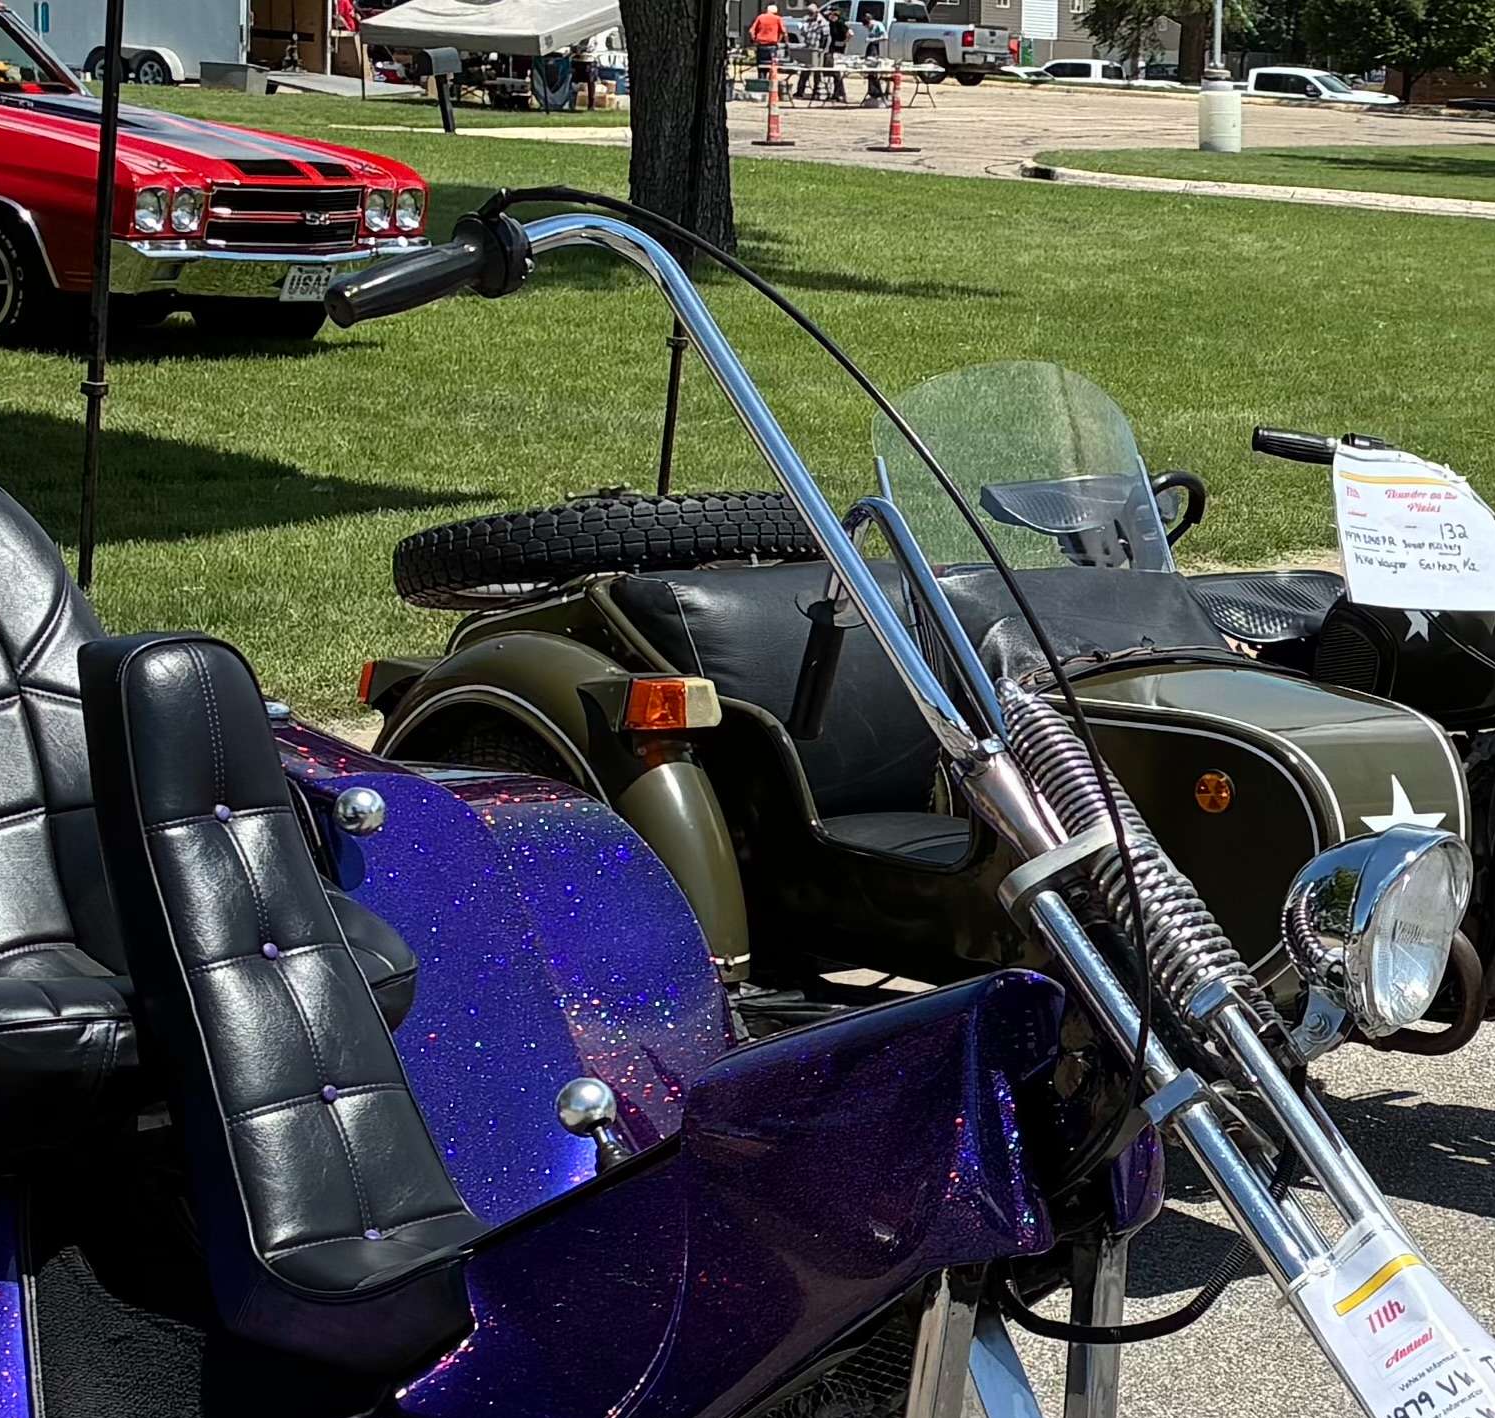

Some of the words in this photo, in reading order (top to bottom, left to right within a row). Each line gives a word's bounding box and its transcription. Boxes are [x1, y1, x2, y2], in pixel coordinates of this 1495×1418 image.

[1439, 523, 1469, 540] 132
[1366, 1299, 1406, 1335] 11th
[1385, 1327, 1434, 1369] Annual
